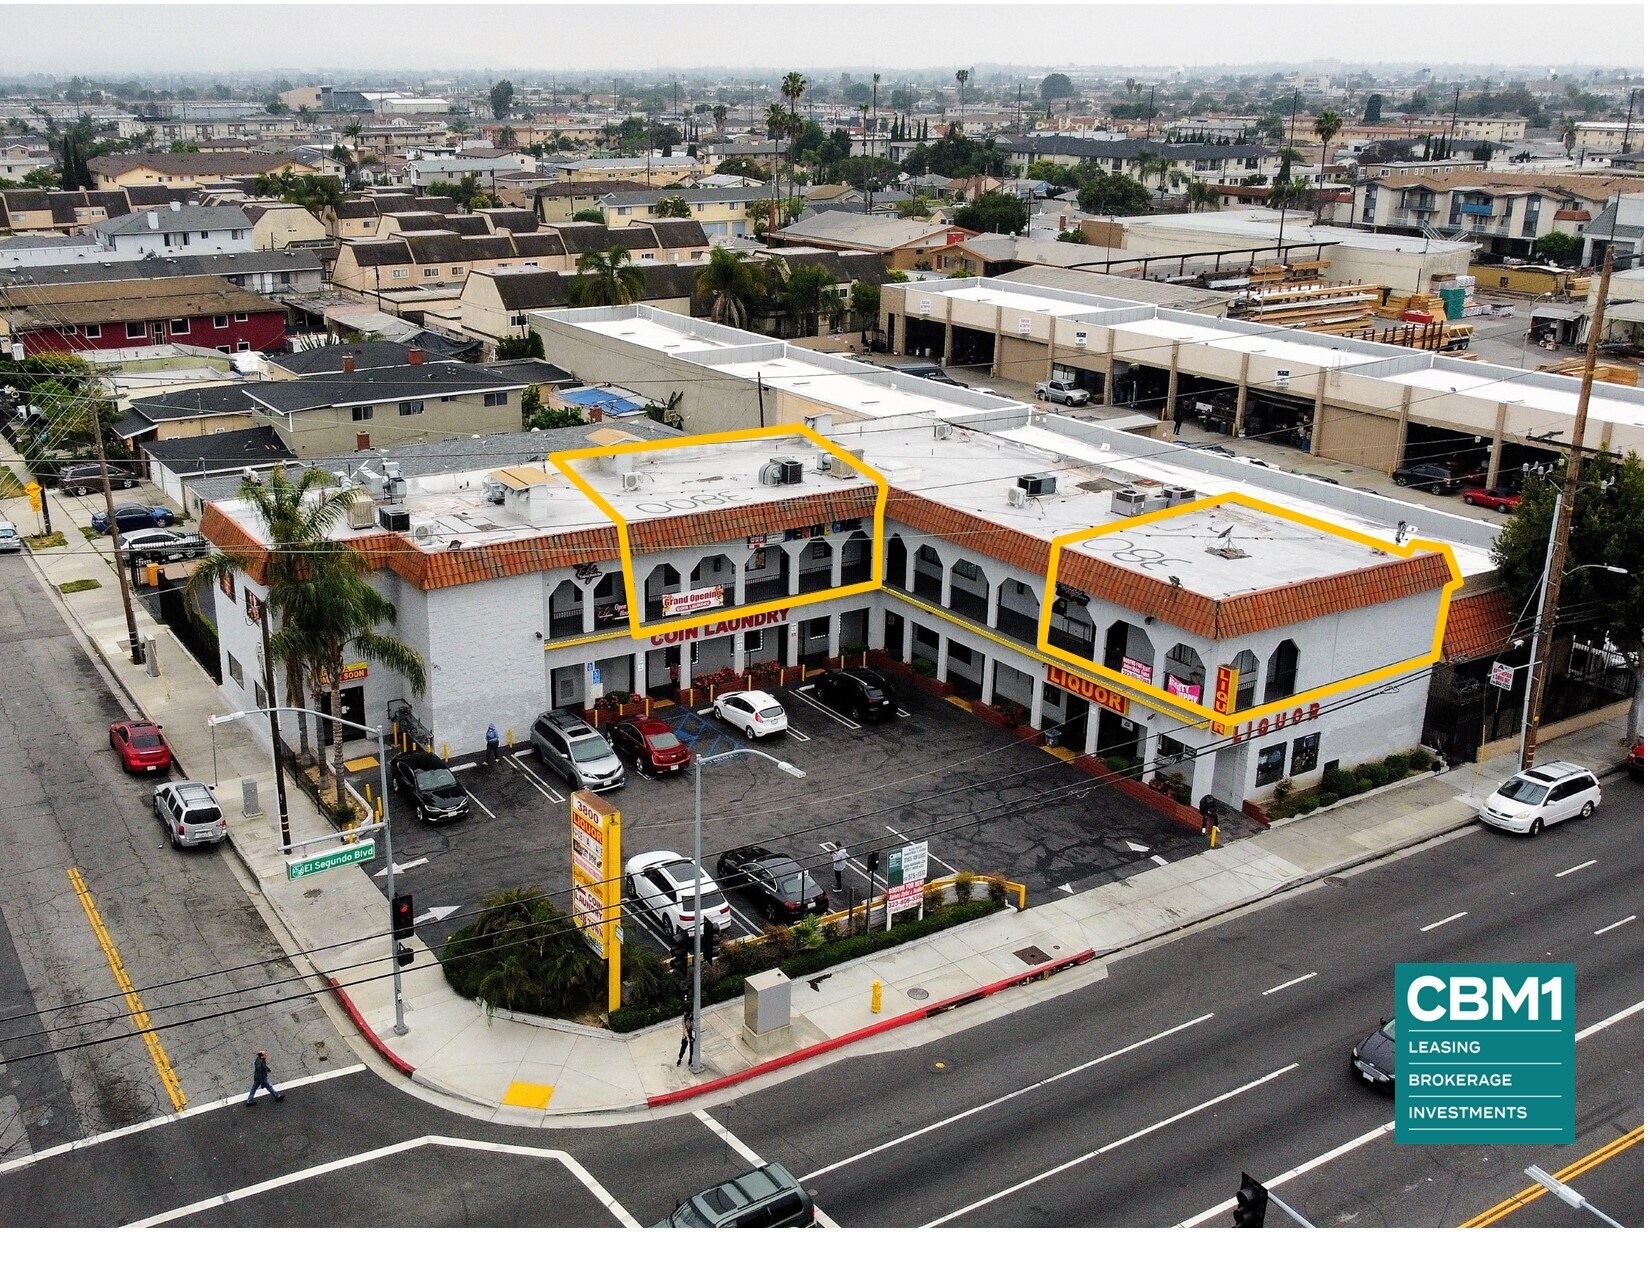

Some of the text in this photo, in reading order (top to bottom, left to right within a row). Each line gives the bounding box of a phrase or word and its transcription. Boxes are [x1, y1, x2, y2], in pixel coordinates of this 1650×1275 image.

[664, 590, 722, 606] Grand Opening
[650, 607, 790, 646] COIN LAUNDRY
[343, 669, 365, 680] SOON
[1050, 667, 1122, 711] LIQUOR
[1213, 669, 1230, 734] LIQUR
[1232, 702, 1321, 743] LIQUOR
[573, 812, 603, 843] LIQUOR
[577, 801, 599, 824] 3800
[304, 846, 373, 872] El Segundo Blvd
[575, 891, 603, 920] LAUNDRY
